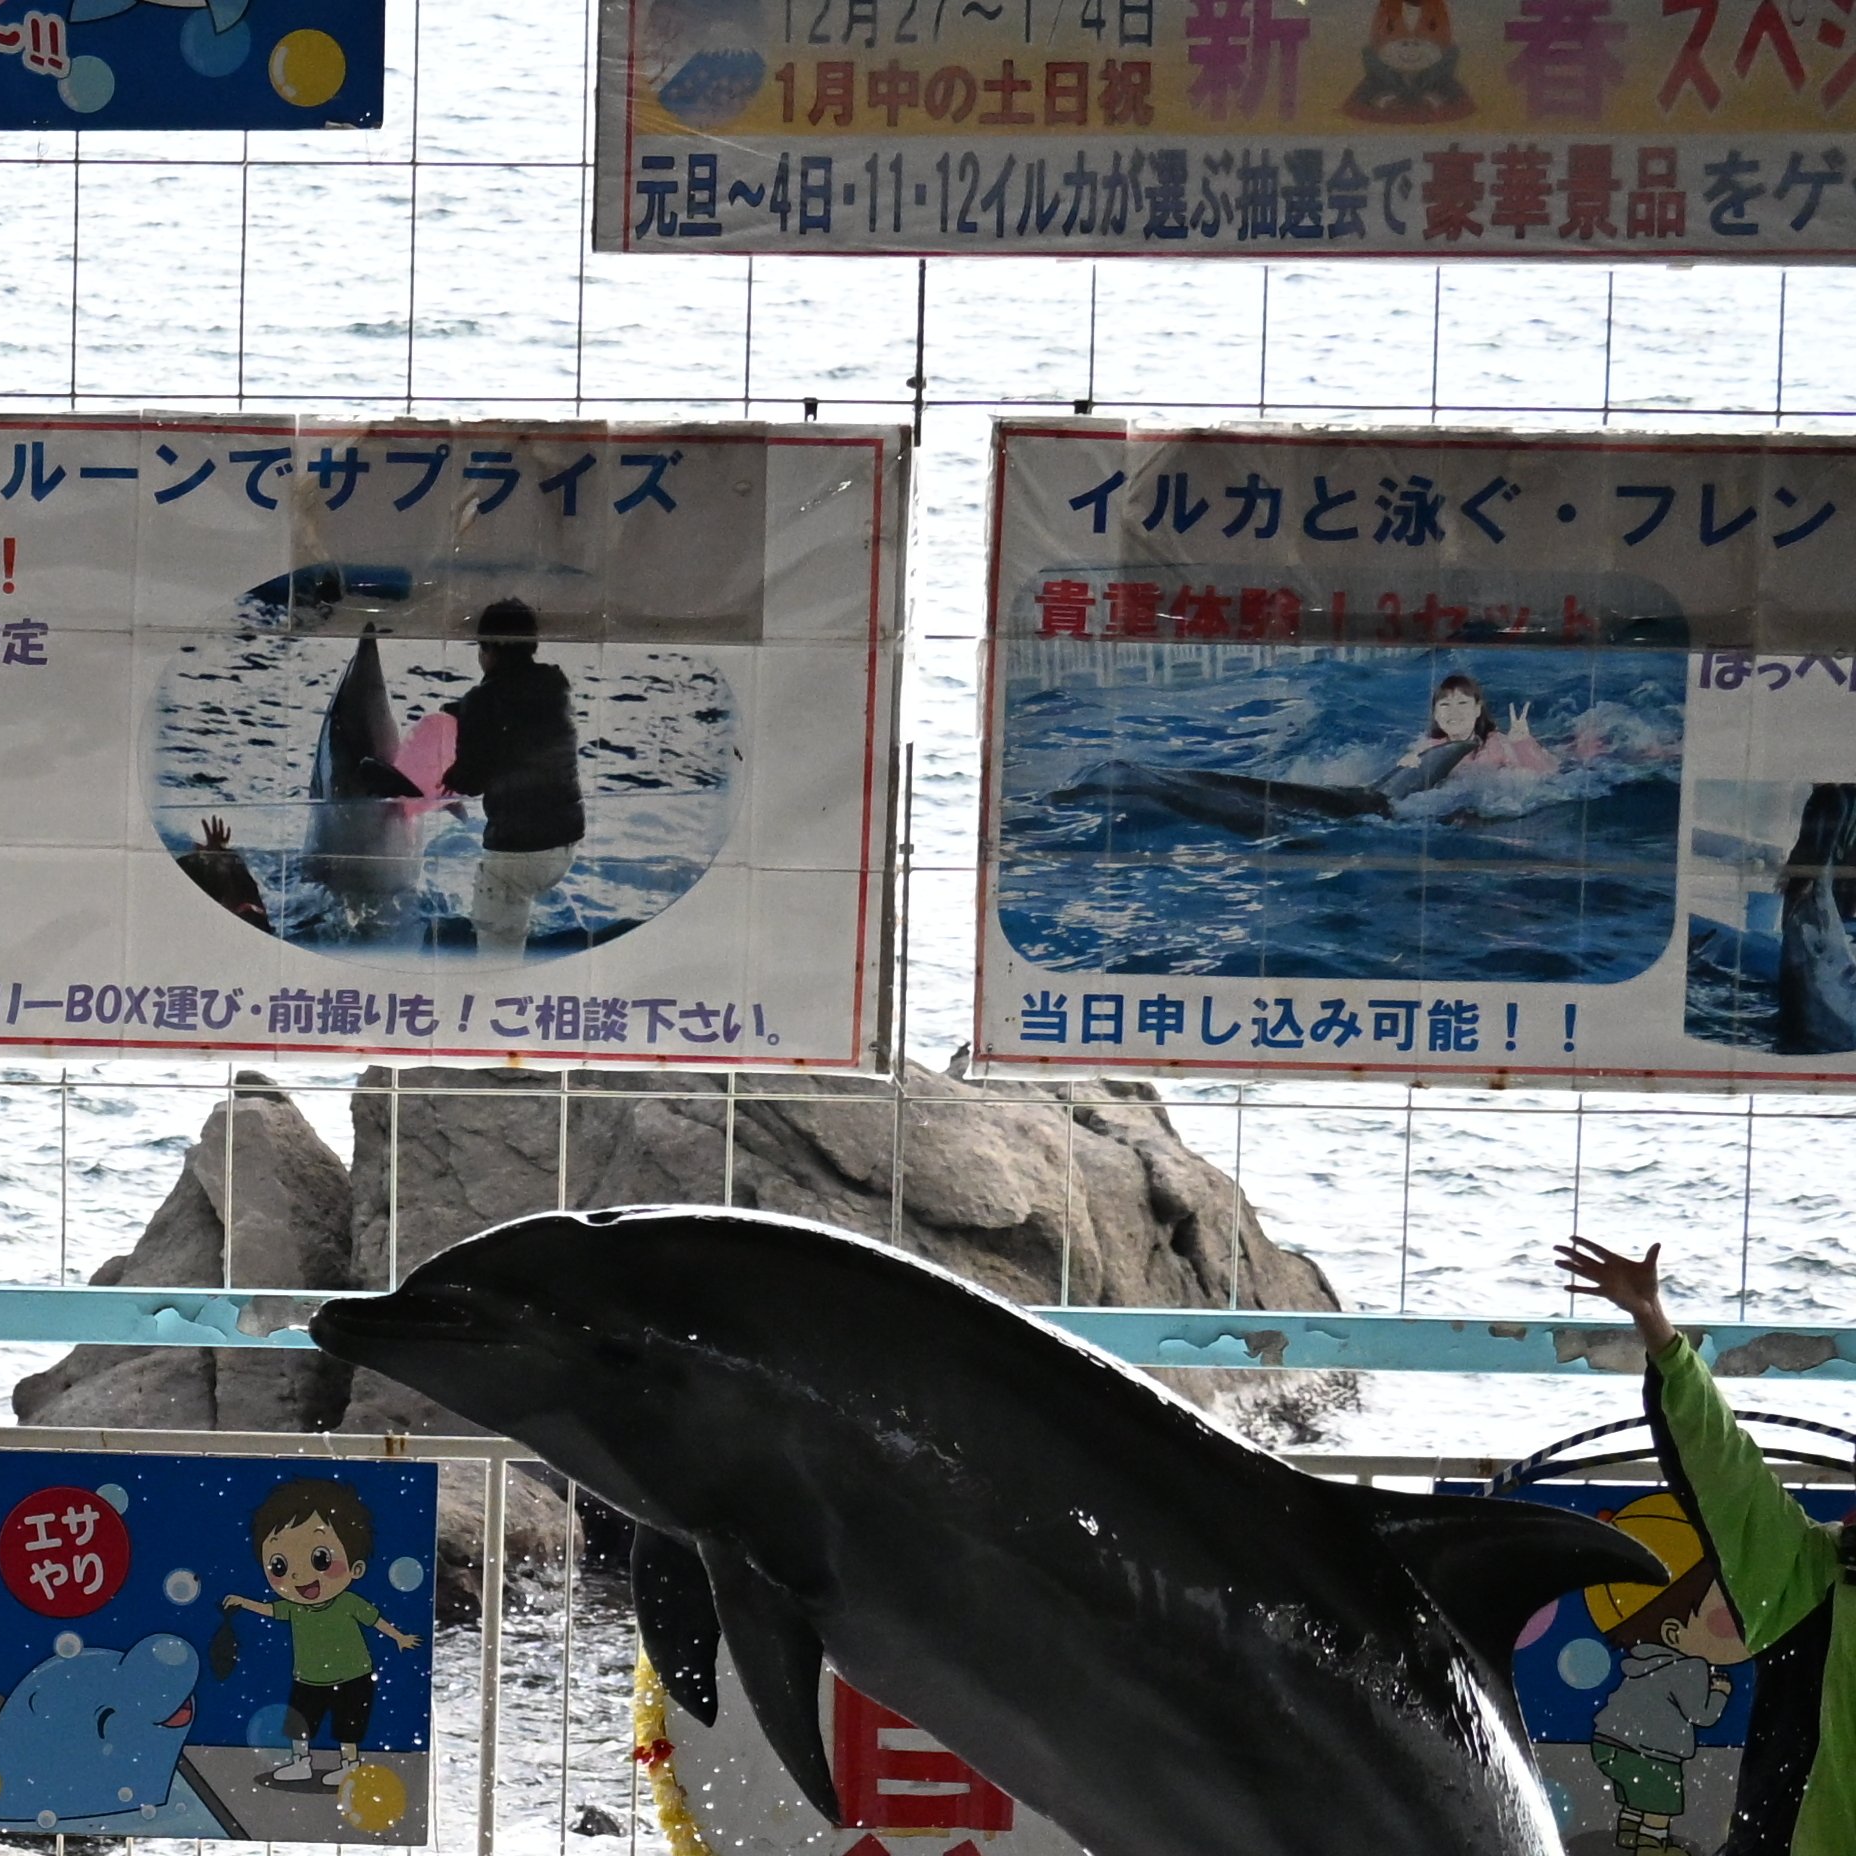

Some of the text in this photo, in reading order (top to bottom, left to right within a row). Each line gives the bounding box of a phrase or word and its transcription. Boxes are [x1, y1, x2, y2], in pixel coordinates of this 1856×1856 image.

[774, 57, 1155, 128] 1月中の土日祝
[23, 1503, 101, 1552] エサ
[28, 1552, 105, 1601] やり
